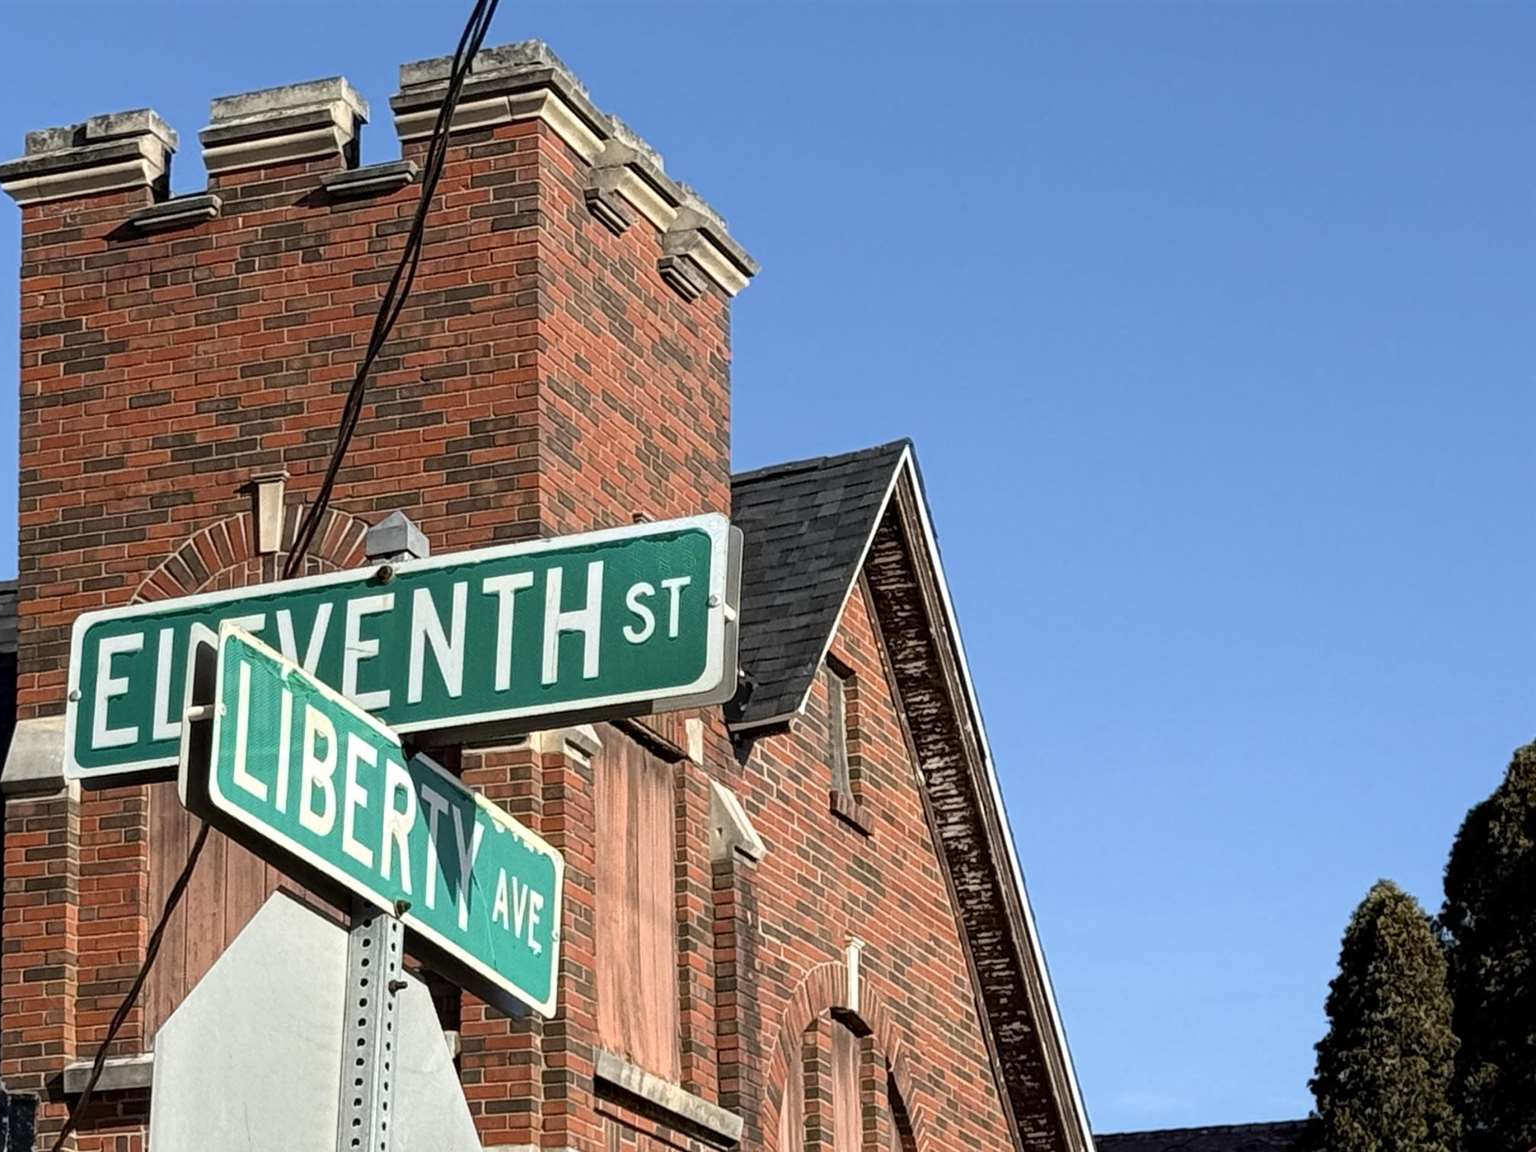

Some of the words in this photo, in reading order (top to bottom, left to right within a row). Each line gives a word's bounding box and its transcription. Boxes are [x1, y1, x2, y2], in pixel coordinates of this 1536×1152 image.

[91, 560, 604, 749] ELVENTH
[622, 575, 691, 644] ST
[233, 660, 485, 932] LIBERTY
[492, 867, 544, 956] AVE
